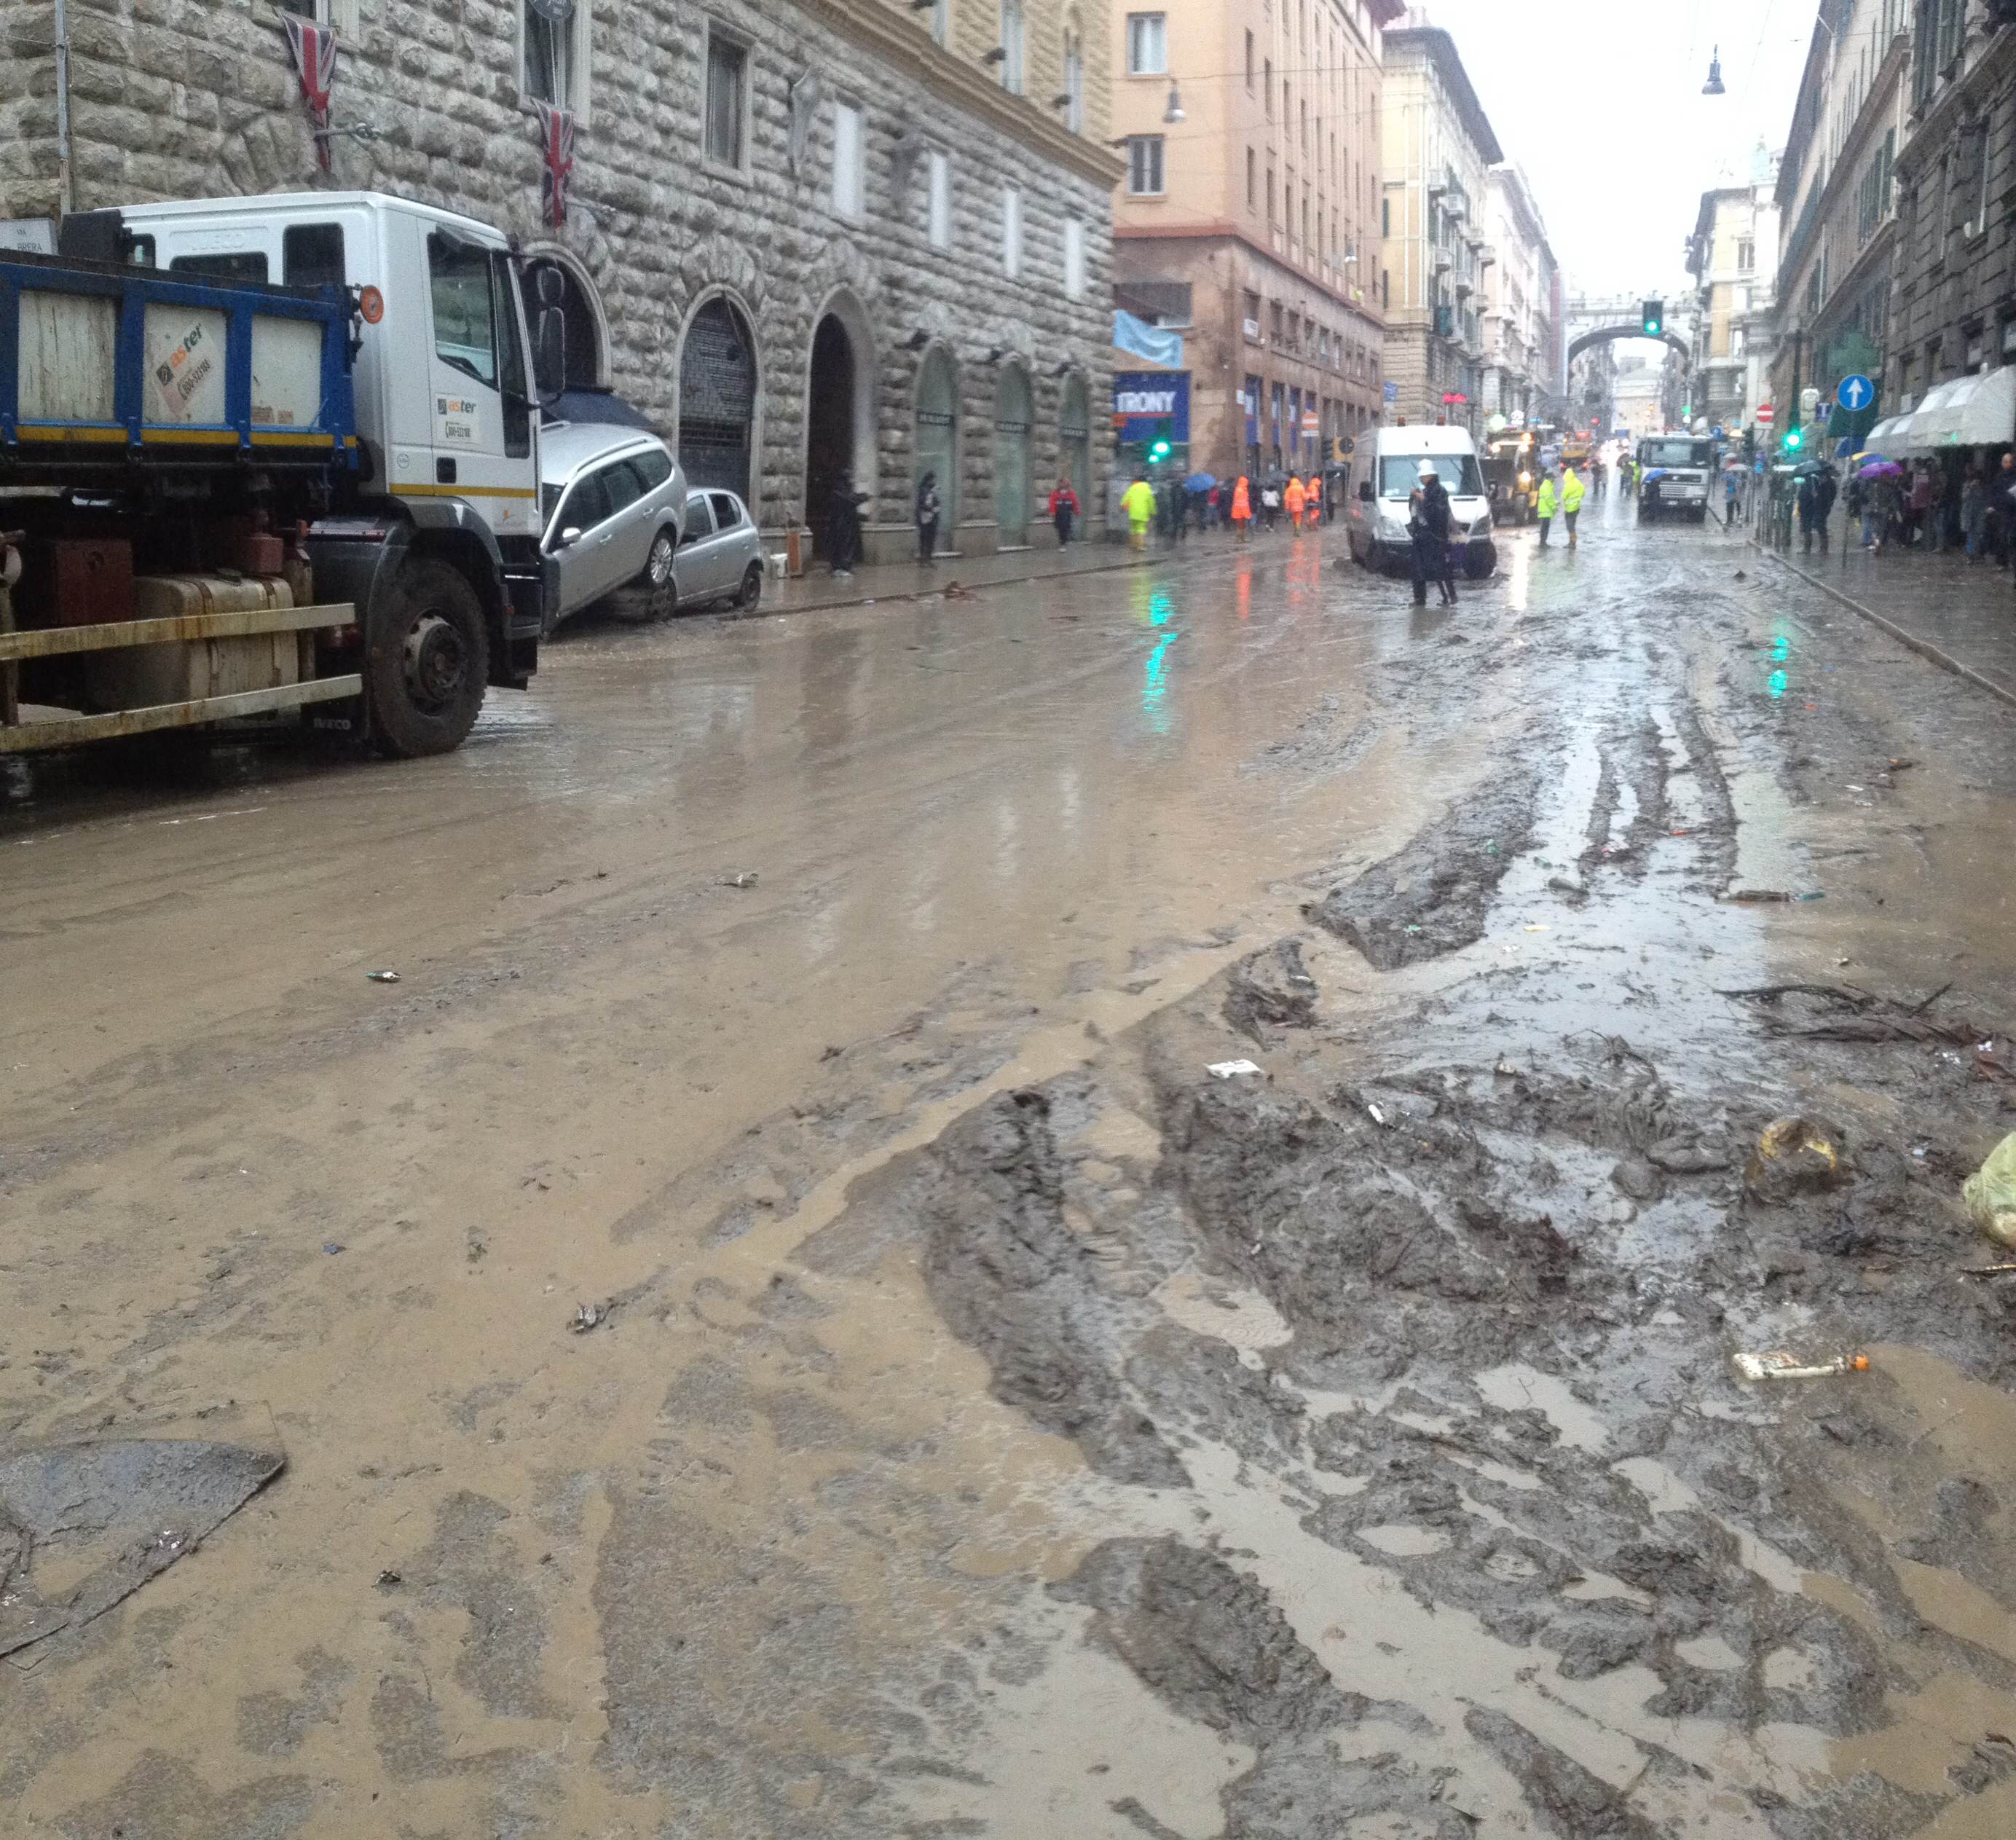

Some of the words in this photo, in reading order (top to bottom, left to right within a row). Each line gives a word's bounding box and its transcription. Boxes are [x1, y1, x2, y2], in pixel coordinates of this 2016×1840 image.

[17, 243, 42, 252] BRERA
[170, 323, 202, 367] aster
[449, 400, 476, 414] aster
[1117, 391, 1177, 413] TRONY
[314, 717, 351, 730] IVECO
